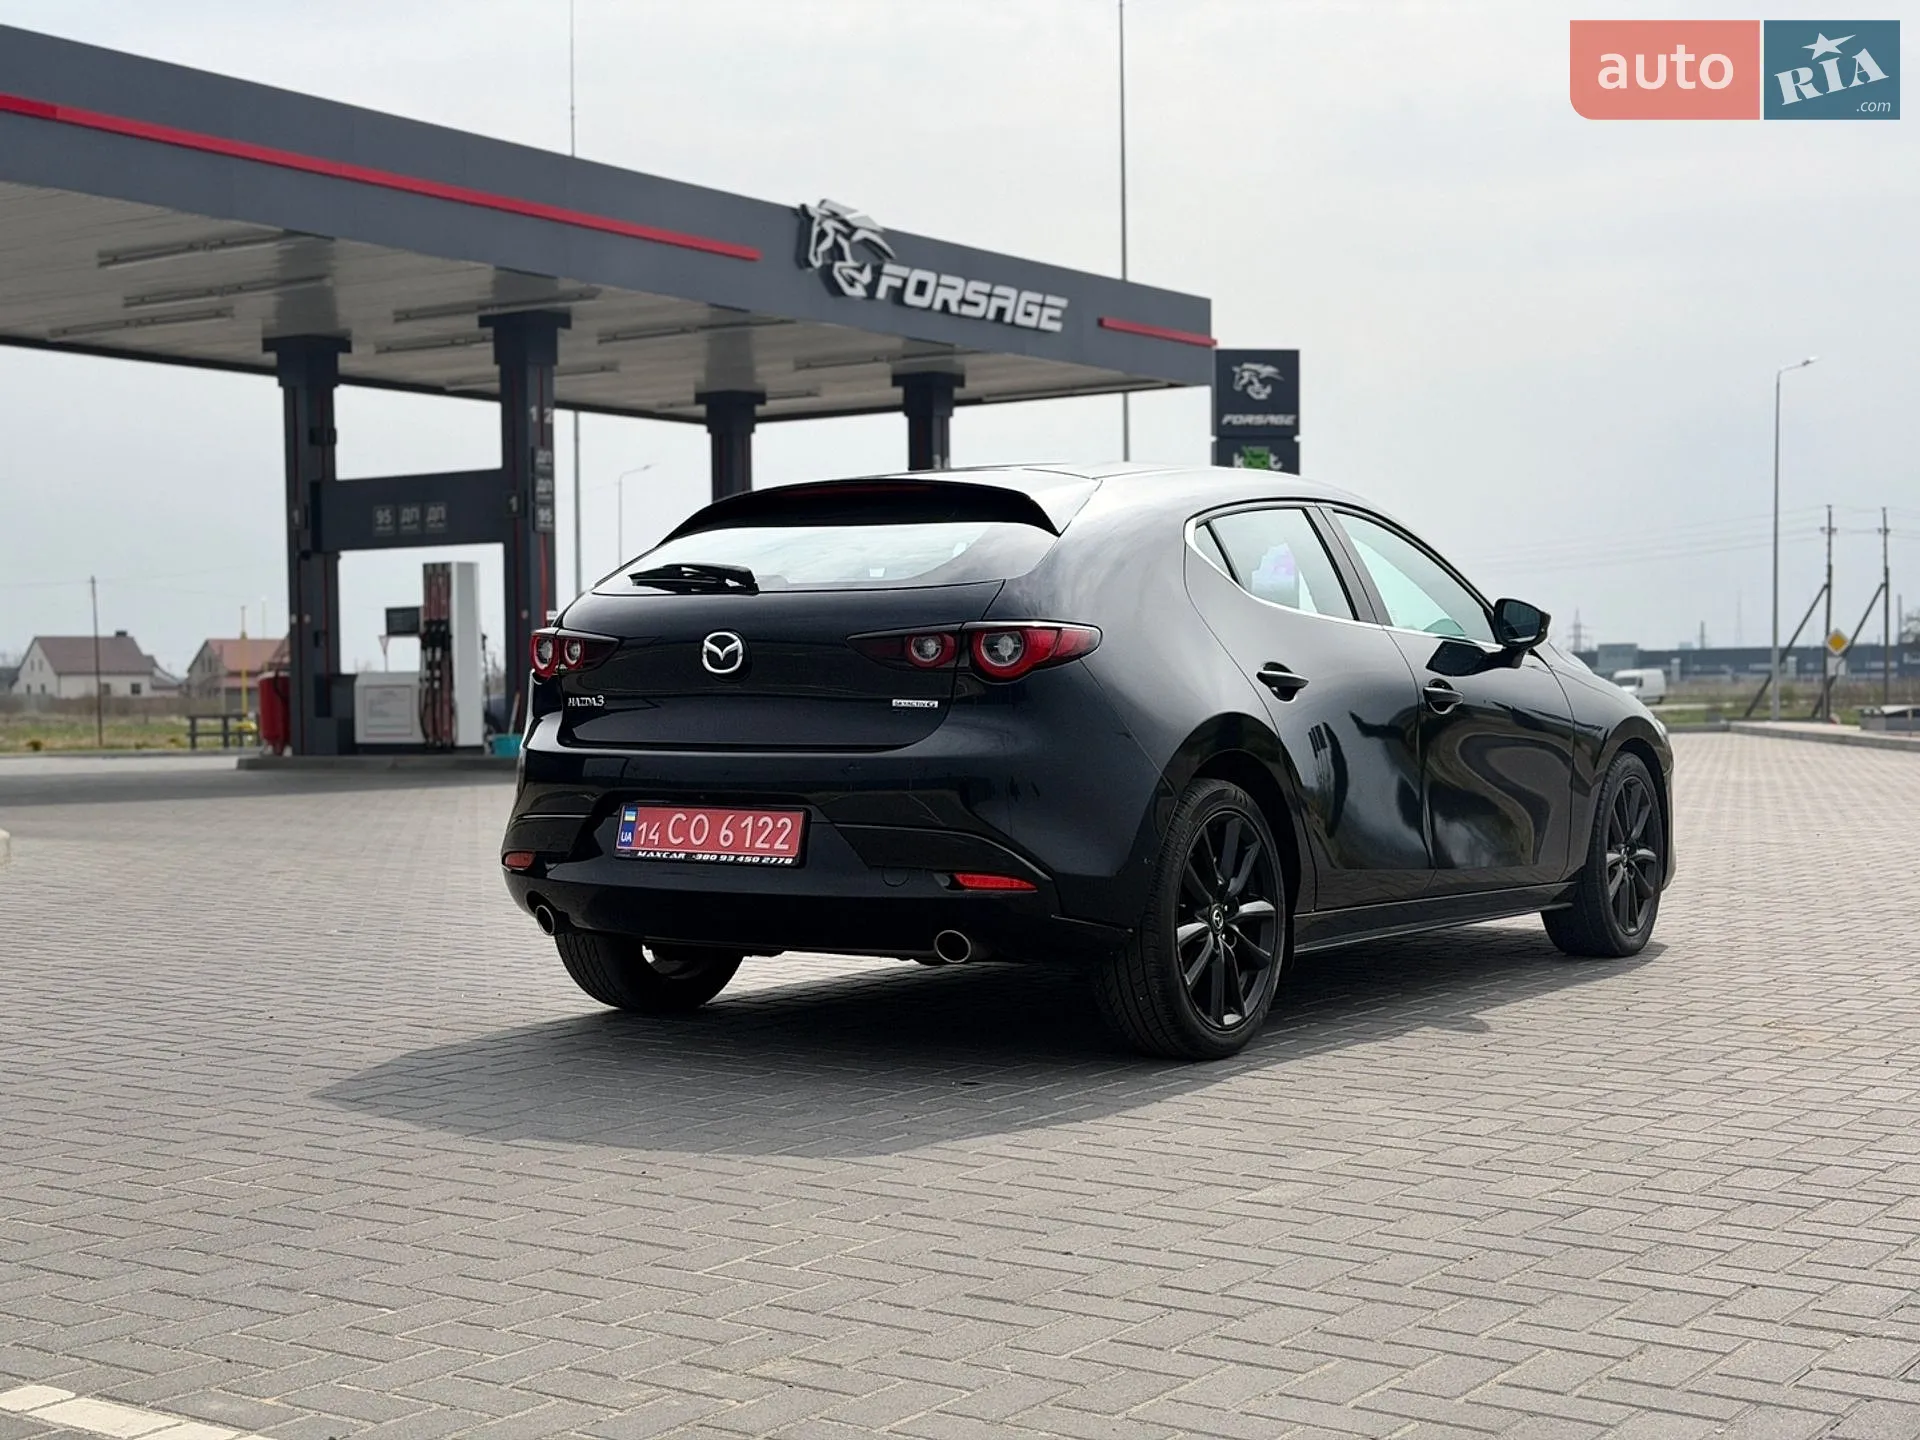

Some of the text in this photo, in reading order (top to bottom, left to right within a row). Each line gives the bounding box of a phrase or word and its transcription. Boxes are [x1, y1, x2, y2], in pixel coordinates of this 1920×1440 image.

[875, 262, 1069, 333] FORSAGE
[1222, 413, 1297, 426] FORSAGE
[620, 831, 633, 843] UA
[637, 813, 793, 850] 14 CO 6122
[637, 850, 686, 859] MAXCAR
